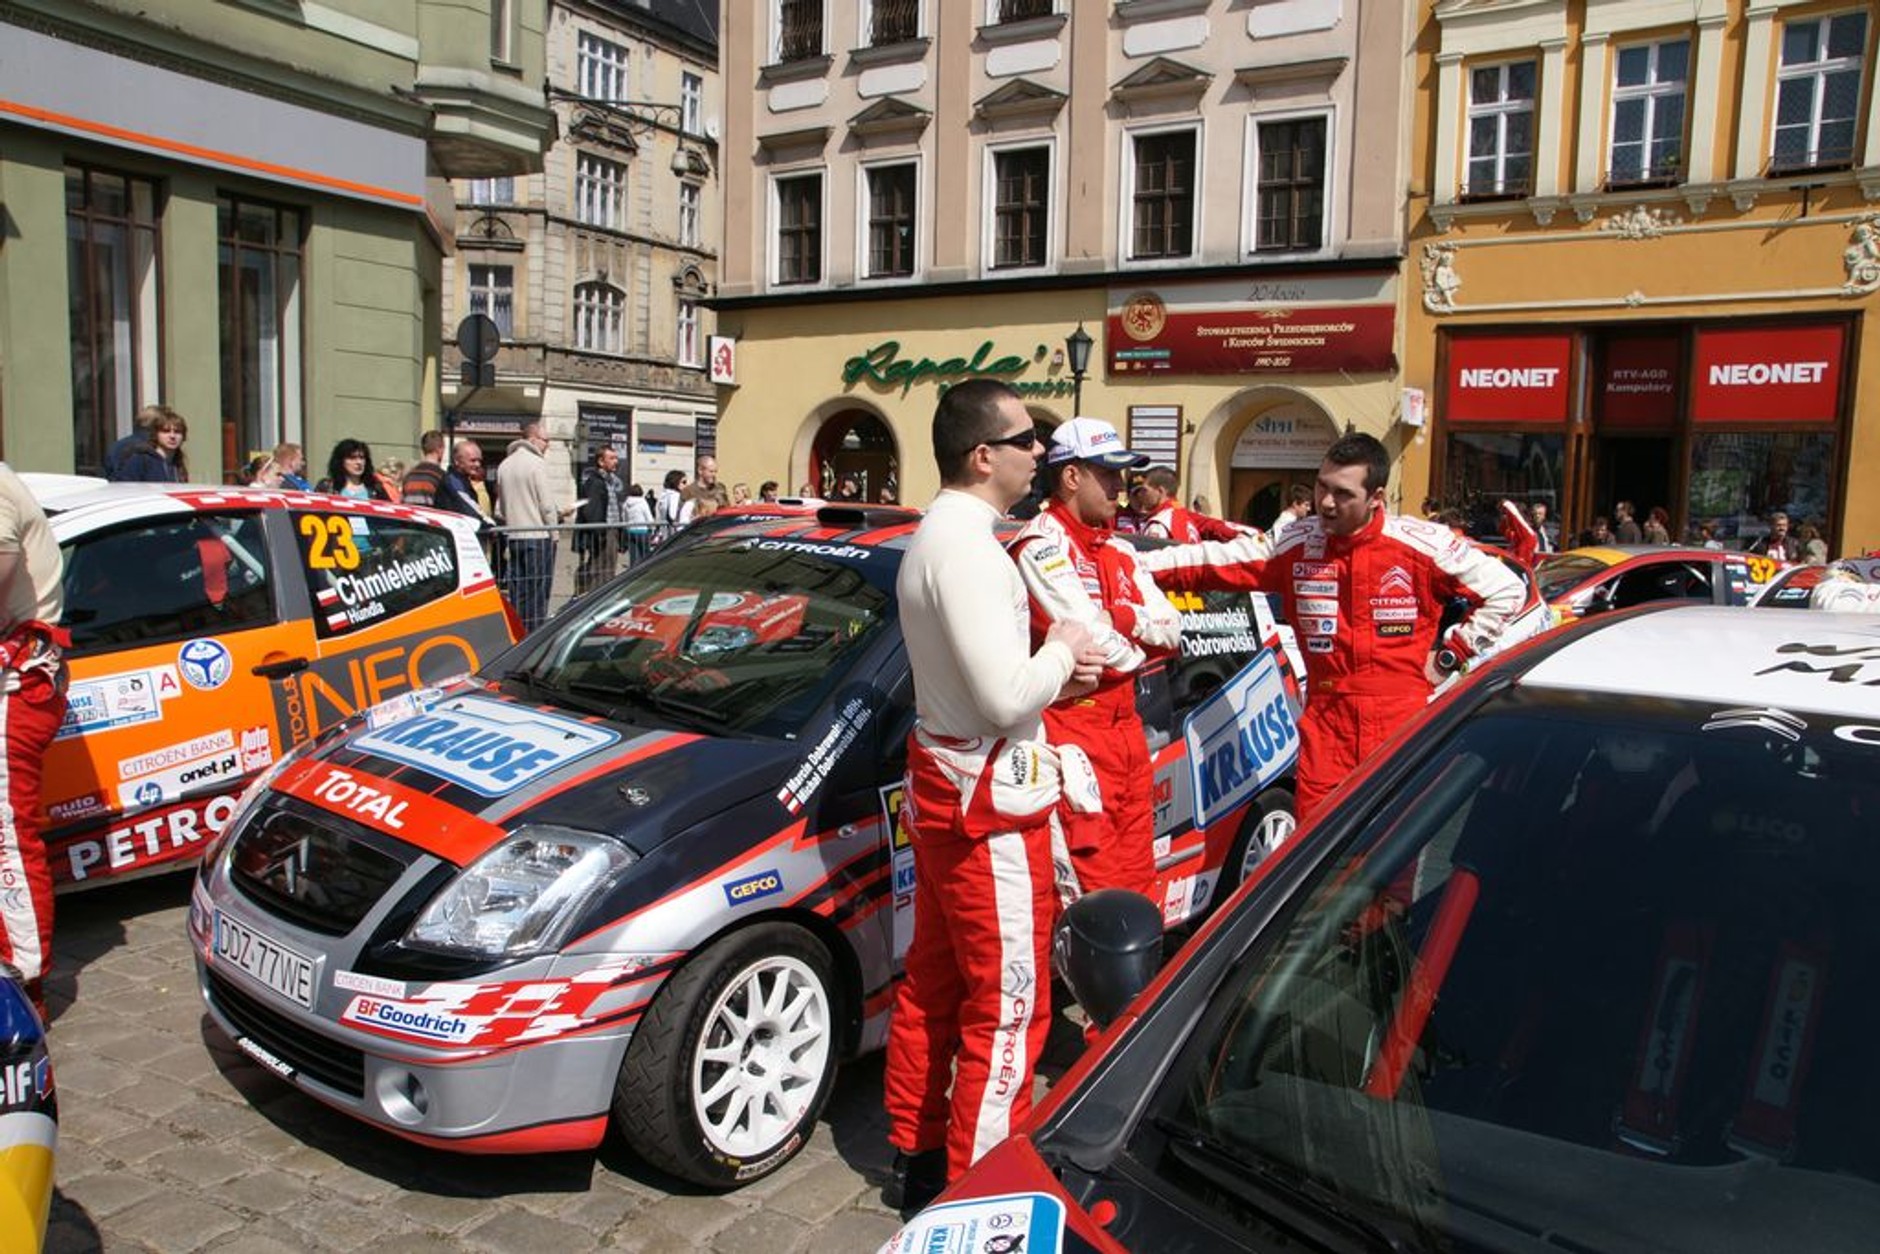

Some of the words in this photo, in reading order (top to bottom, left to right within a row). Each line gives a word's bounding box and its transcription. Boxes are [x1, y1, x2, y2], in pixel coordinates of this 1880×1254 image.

[1460, 367, 1560, 388] NEONET
[1612, 368, 1669, 380] RTV-AGD
[1709, 361, 1829, 386] NEONET
[300, 513, 361, 571] 23
[336, 545, 455, 606] Chmielewski
[1180, 606, 1251, 631] obrowolski
[1181, 631, 1258, 658] Dobrowolski
[160, 672, 177, 692] A
[190, 734, 231, 756] BANK
[371, 714, 561, 783] KRAUSE
[1199, 693, 1296, 812] KRAUSE
[179, 754, 237, 785] onet.pl
[313, 769, 409, 829] TOTAL
[68, 795, 240, 881] PETRO
[730, 875, 778, 899] GEFCO
[220, 918, 251, 971] DDZ
[258, 940, 311, 1003] 77WE
[357, 999, 467, 1034] BFGoodrich
